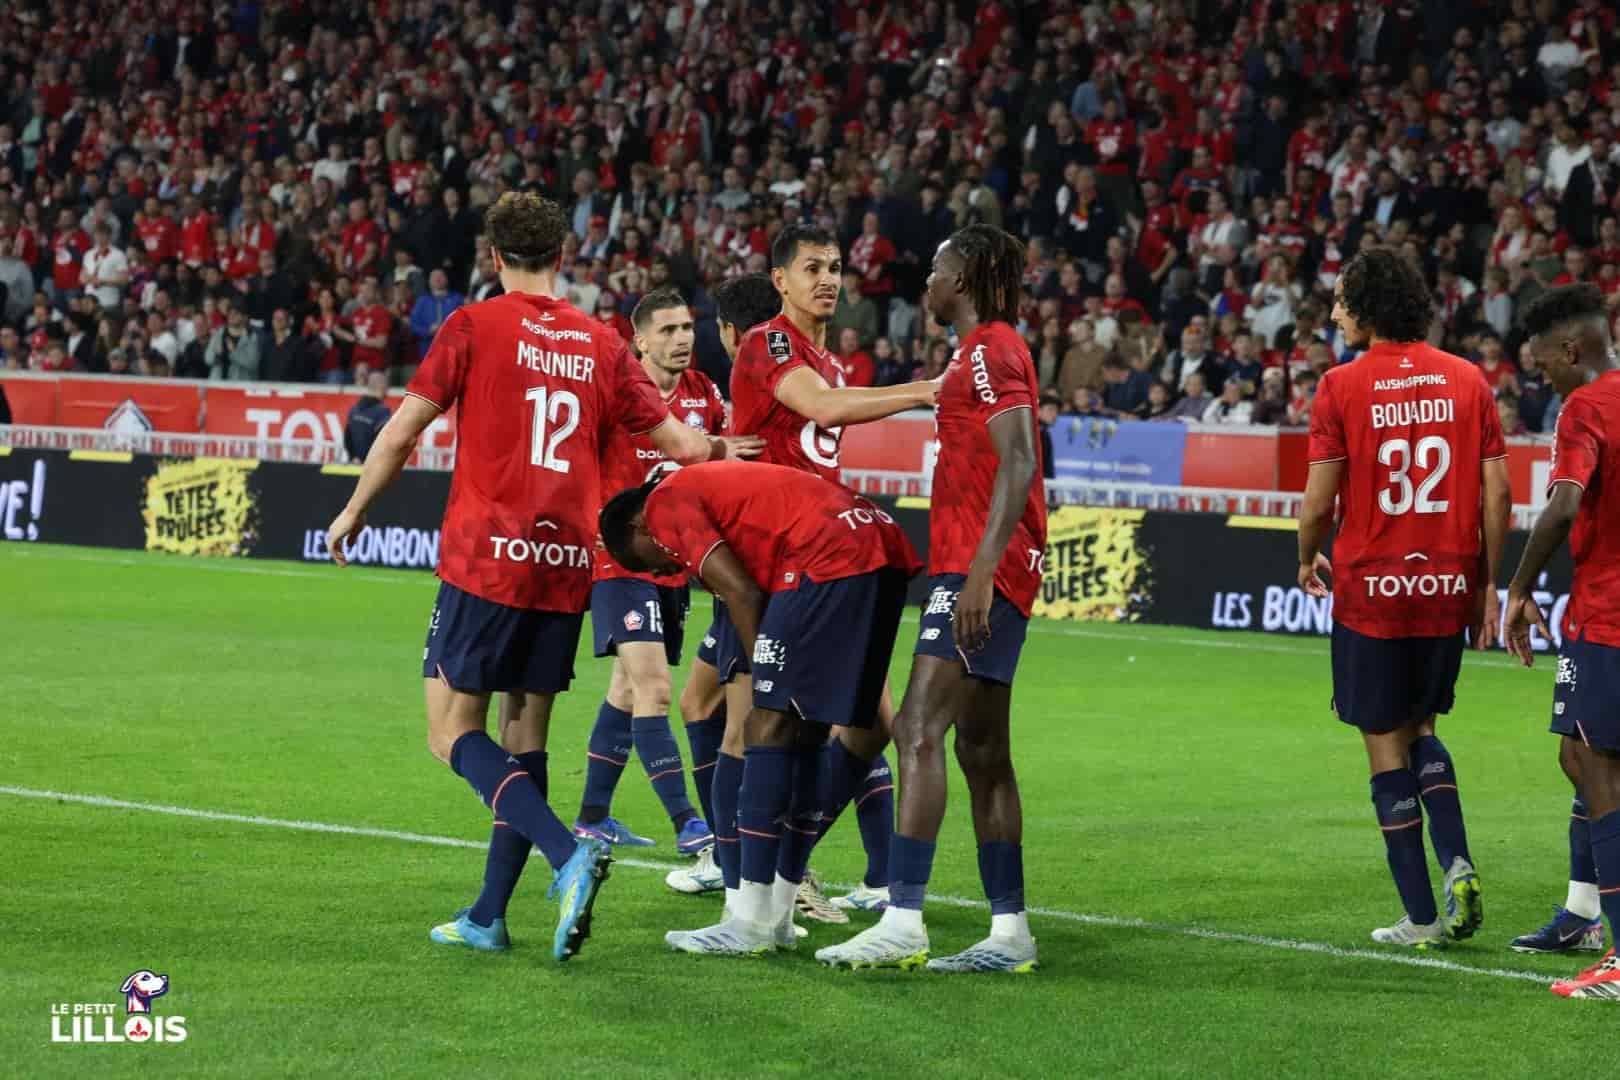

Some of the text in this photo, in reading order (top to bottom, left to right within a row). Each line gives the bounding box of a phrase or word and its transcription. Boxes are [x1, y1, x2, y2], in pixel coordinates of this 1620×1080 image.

[516, 340, 594, 384] MEUNIER
[1374, 374, 1447, 391] AUSHOPPING
[525, 385, 581, 474] 12
[1371, 398, 1454, 429] BOUADDI
[1378, 435, 1451, 515] 32
[490, 536, 590, 569] TOYOTA
[1364, 574, 1468, 597] TOYOTA
[1212, 591, 1252, 628] LES
